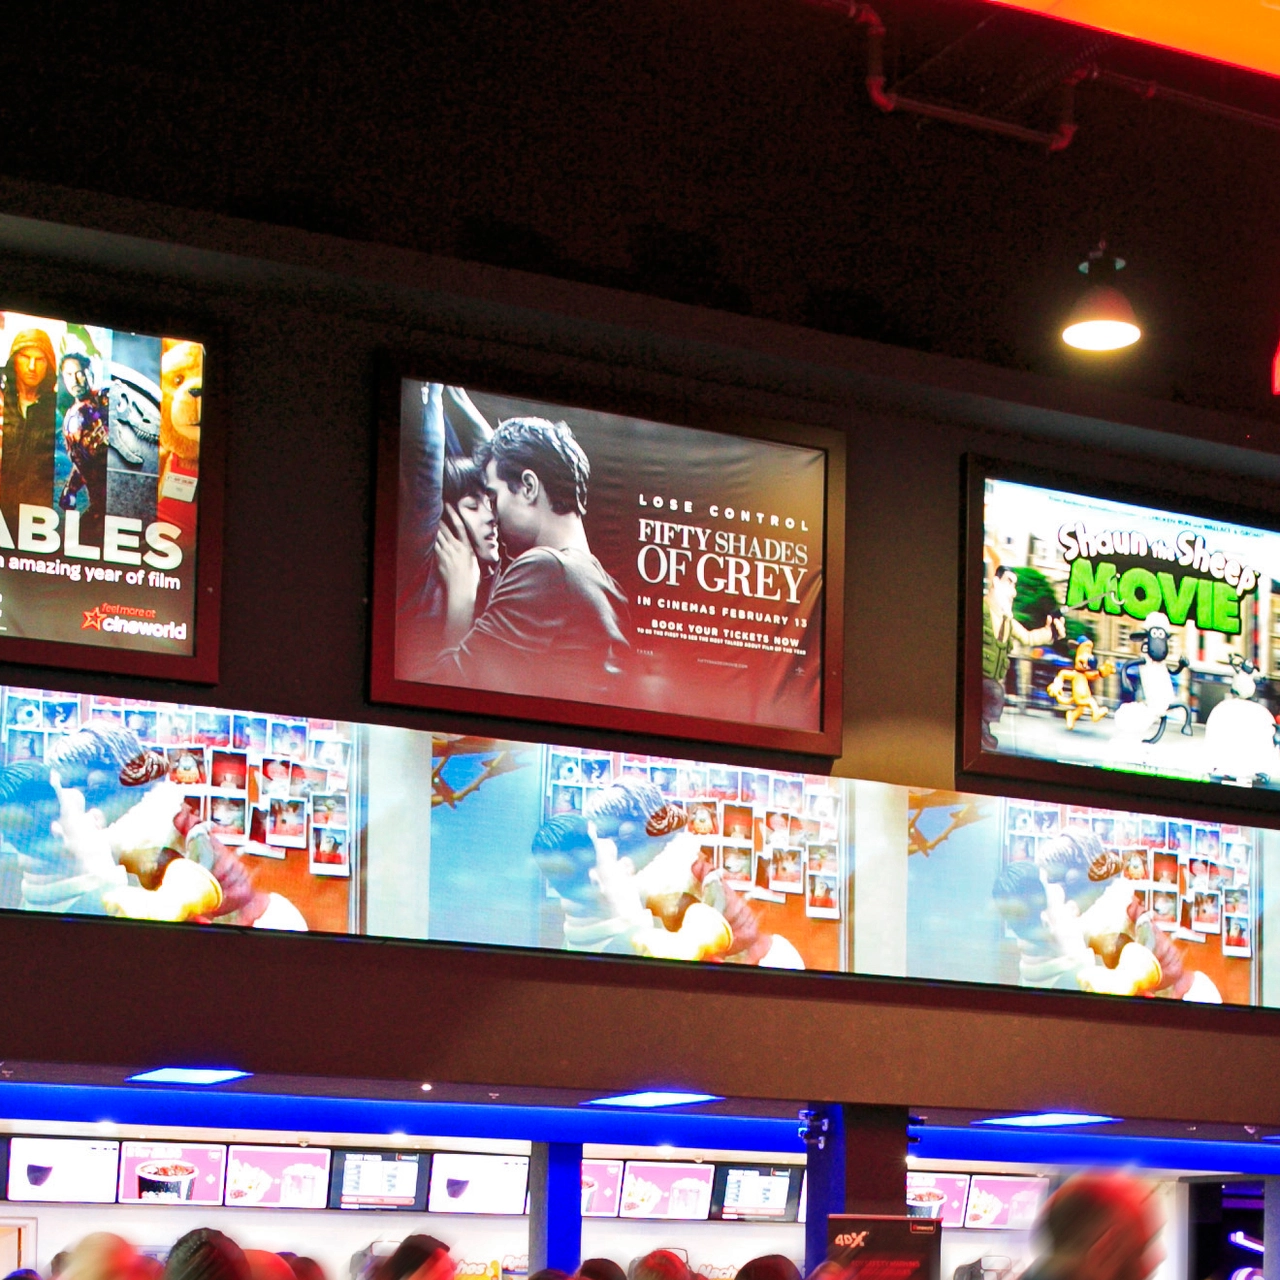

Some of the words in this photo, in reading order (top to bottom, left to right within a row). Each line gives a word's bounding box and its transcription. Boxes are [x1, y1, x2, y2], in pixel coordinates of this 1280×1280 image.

[639, 494, 692, 512] LOSE
[709, 505, 808, 531] CONTROL
[638, 518, 712, 551] FIFTY
[715, 531, 808, 566] SHADES
[1058, 520, 1148, 561] Shaun
[1176, 530, 1257, 597] Sheep
[9, 556, 81, 581] amazing
[84, 566, 122, 582] year
[126, 569, 145, 586] of
[148, 572, 181, 590] film
[637, 544, 692, 586] OF
[696, 553, 808, 604] GREY
[101, 602, 119, 614] feel
[120, 606, 145, 616] more
[145, 608, 156, 618] at
[637, 595, 651, 606] IN
[657, 598, 716, 615] CINEMAS
[722, 607, 788, 627] FEBRUARY
[794, 618, 808, 628] 13
[1066, 558, 1243, 635] MOVIE
[102, 616, 186, 640] cineworld
[651, 619, 683, 631] BOOK
[688, 623, 718, 636] YOUR
[723, 629, 769, 644] TICKETS
[773, 635, 799, 647] NOW
[834, 1231, 868, 1249] 4DX
